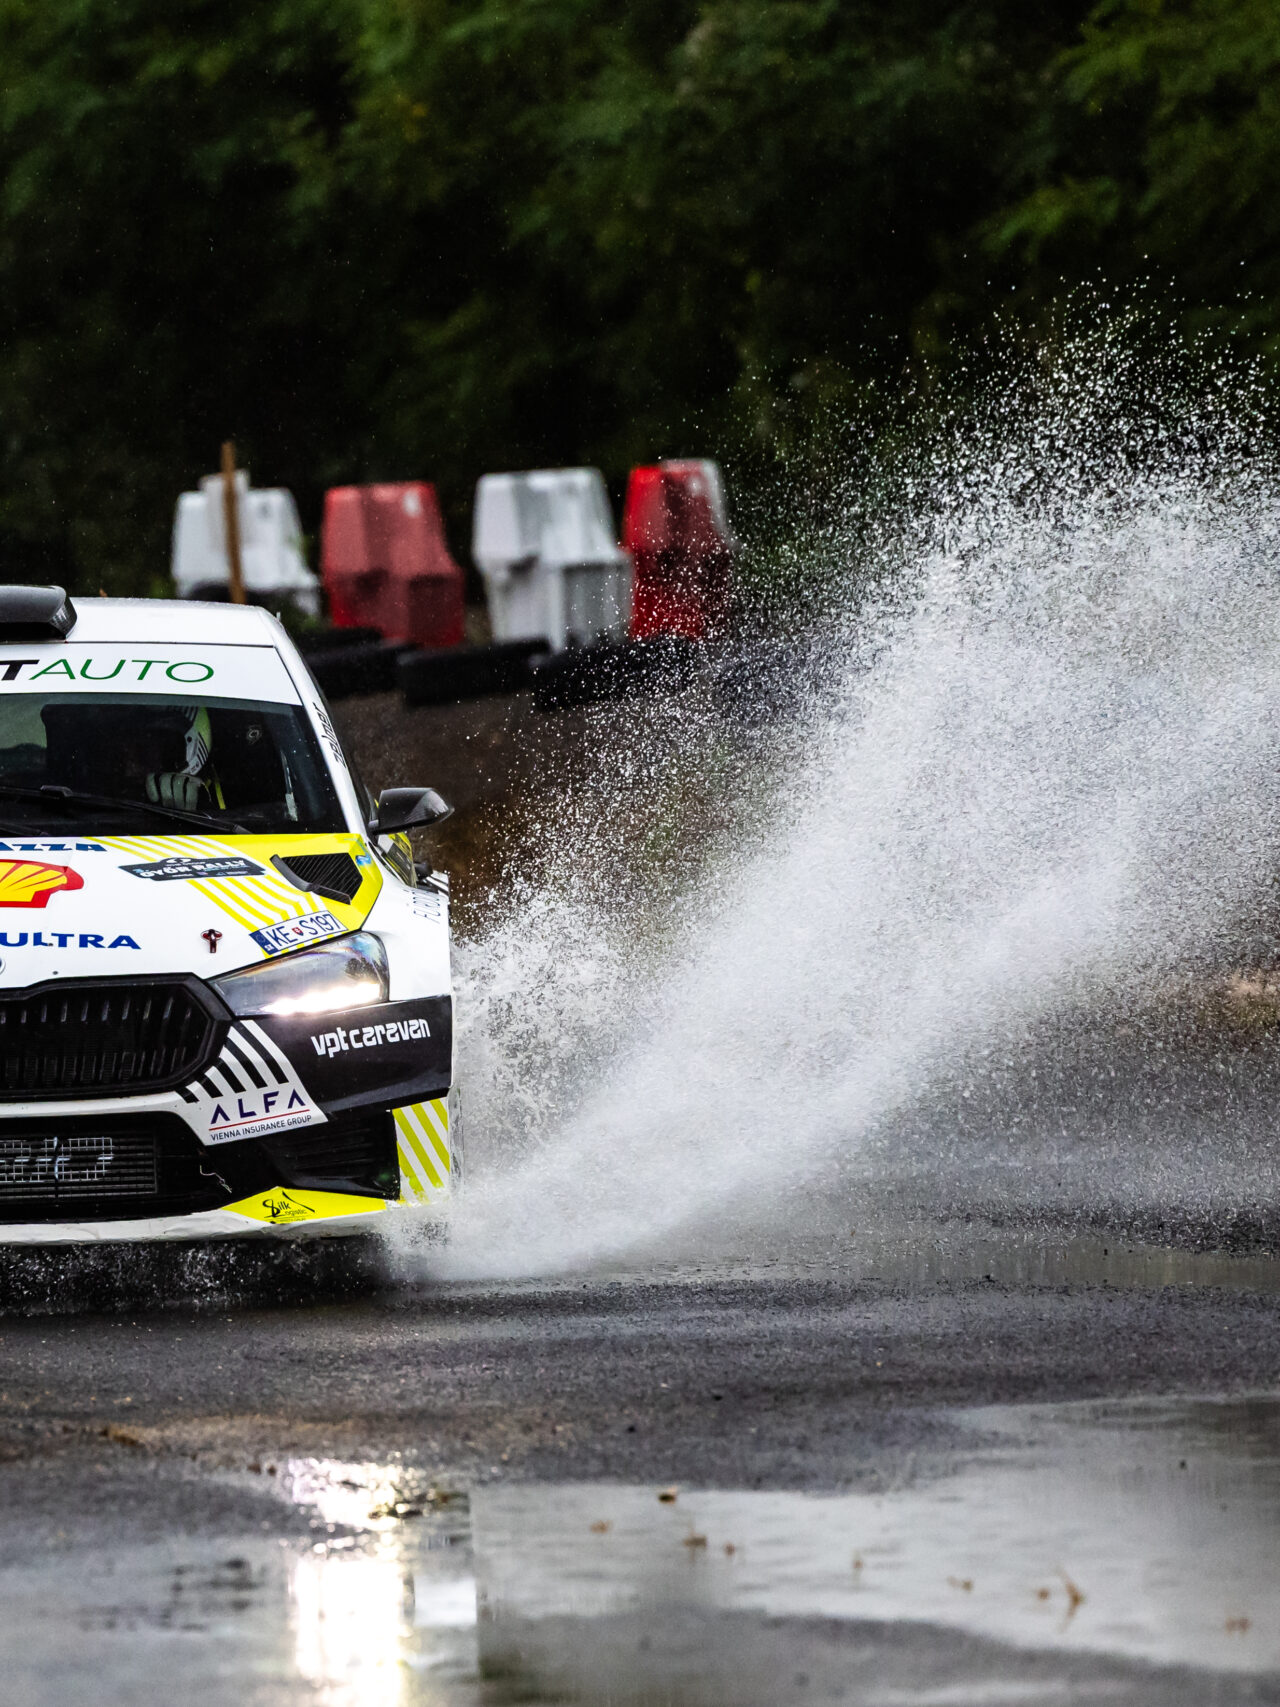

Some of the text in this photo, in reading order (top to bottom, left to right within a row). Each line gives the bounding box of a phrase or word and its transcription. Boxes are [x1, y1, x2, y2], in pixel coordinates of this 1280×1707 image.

[192, 859, 247, 872] RALLY
[266, 914, 340, 946] KE S197
[210, 1089, 306, 1124] ALFA
[210, 1115, 312, 1141] VIENNA INSURANCE GROUP
